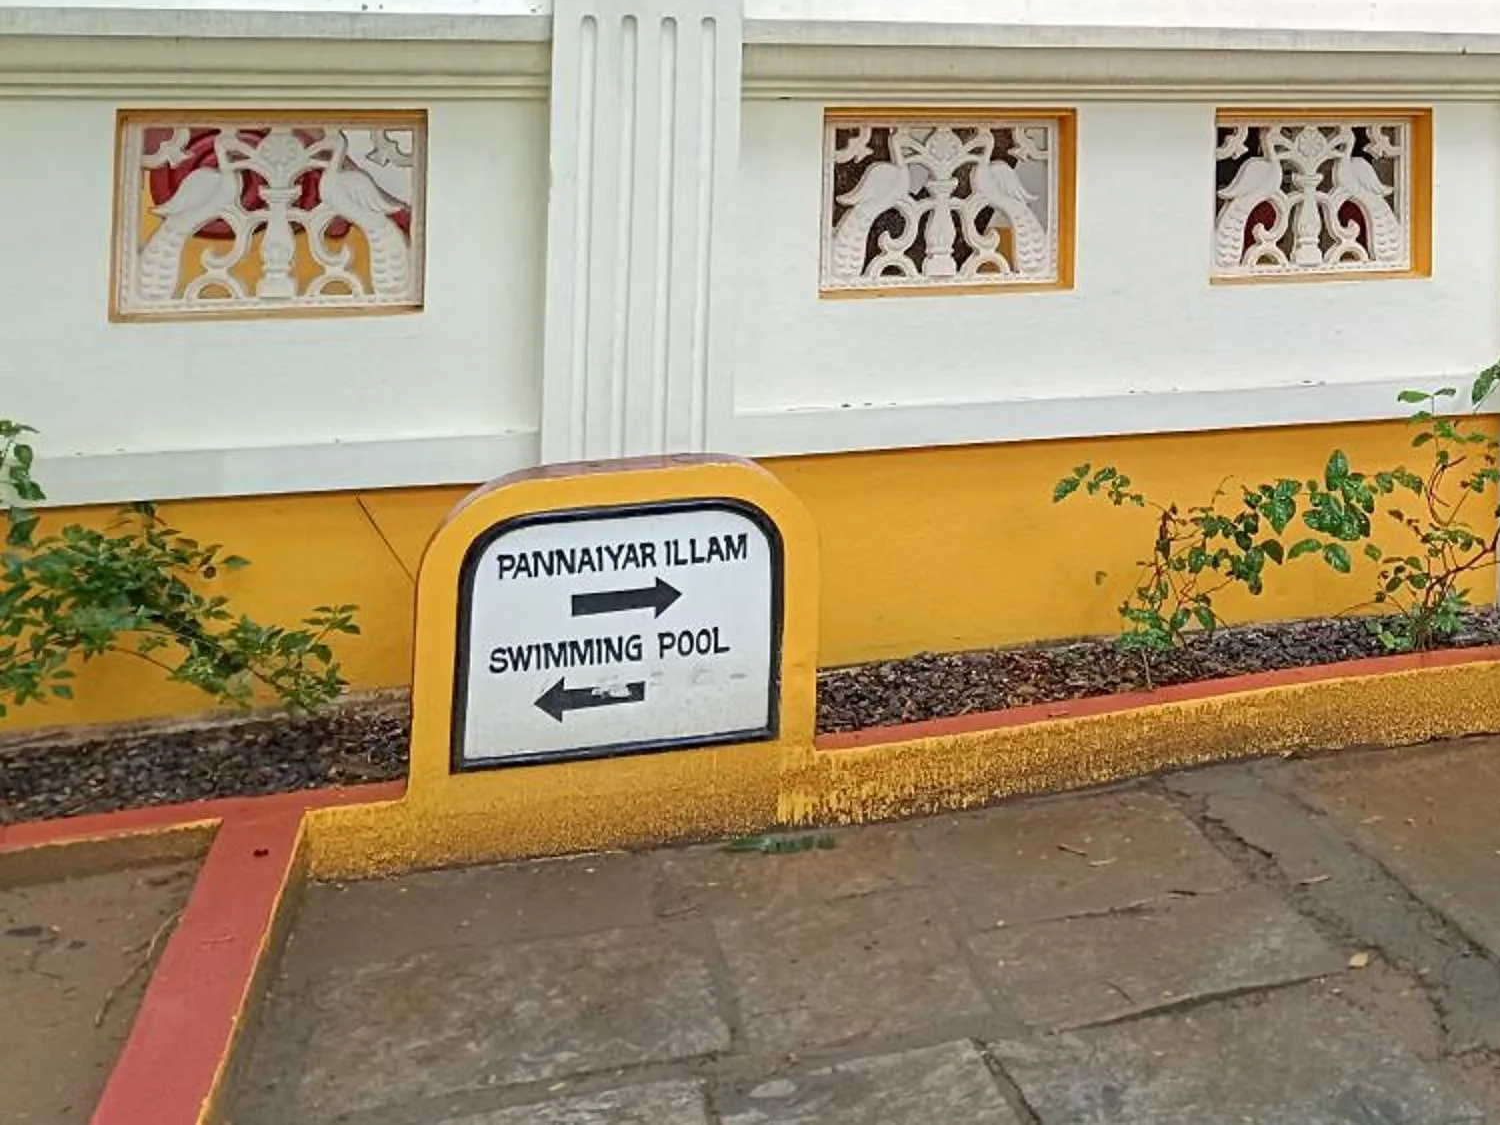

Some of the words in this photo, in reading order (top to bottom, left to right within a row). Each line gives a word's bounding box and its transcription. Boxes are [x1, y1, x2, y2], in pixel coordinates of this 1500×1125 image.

[497, 542, 657, 579] PANNAIYAR
[665, 533, 748, 566] ILLAM
[489, 634, 643, 673] SWIMMING
[658, 626, 730, 659] POOL
